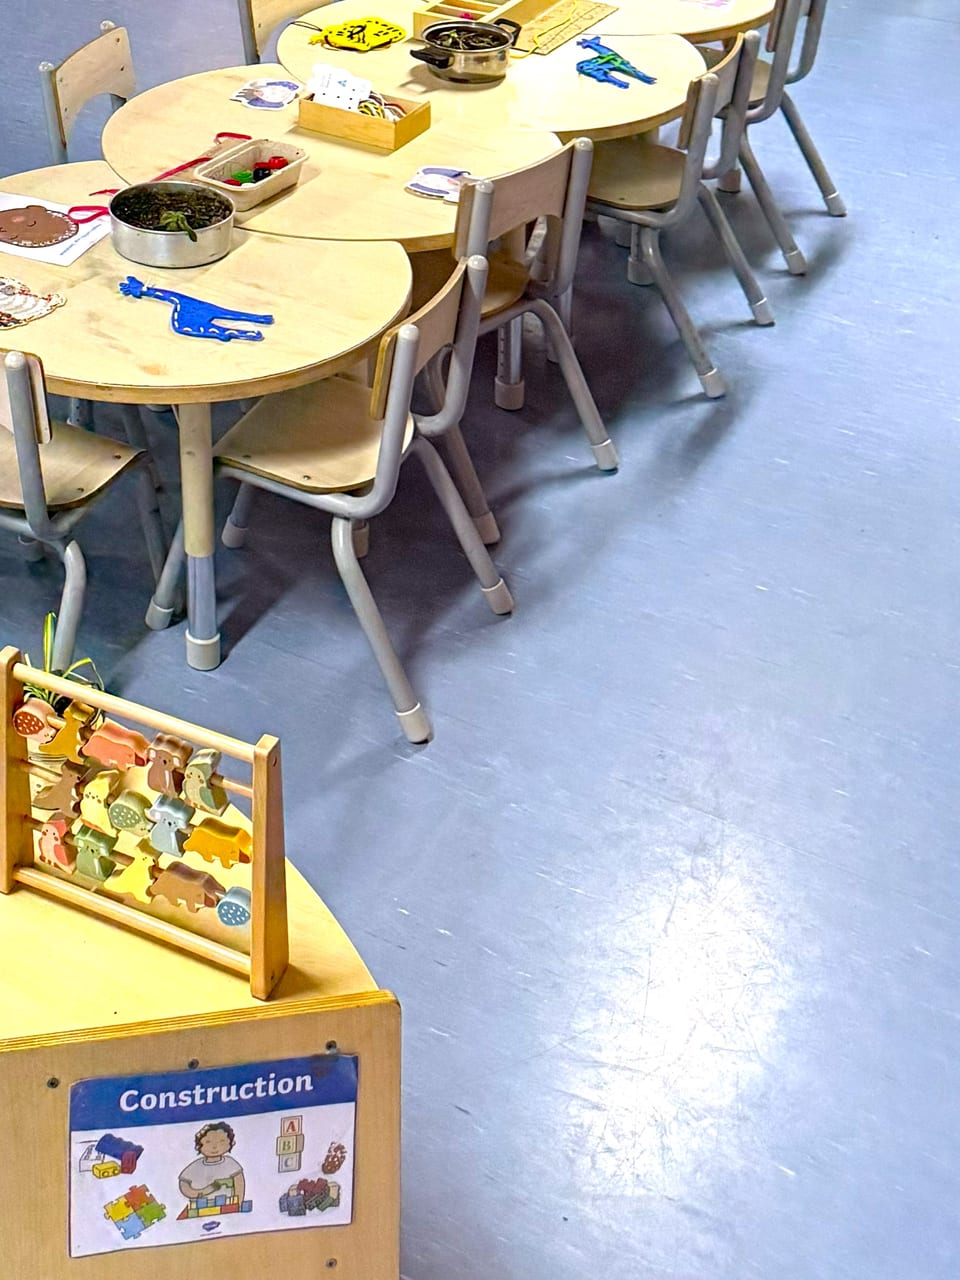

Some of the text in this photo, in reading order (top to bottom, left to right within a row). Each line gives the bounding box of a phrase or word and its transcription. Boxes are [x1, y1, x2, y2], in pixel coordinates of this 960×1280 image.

[119, 1072, 314, 1112] Construction
[286, 1120, 298, 1133] A
[281, 1140, 292, 1152] B
